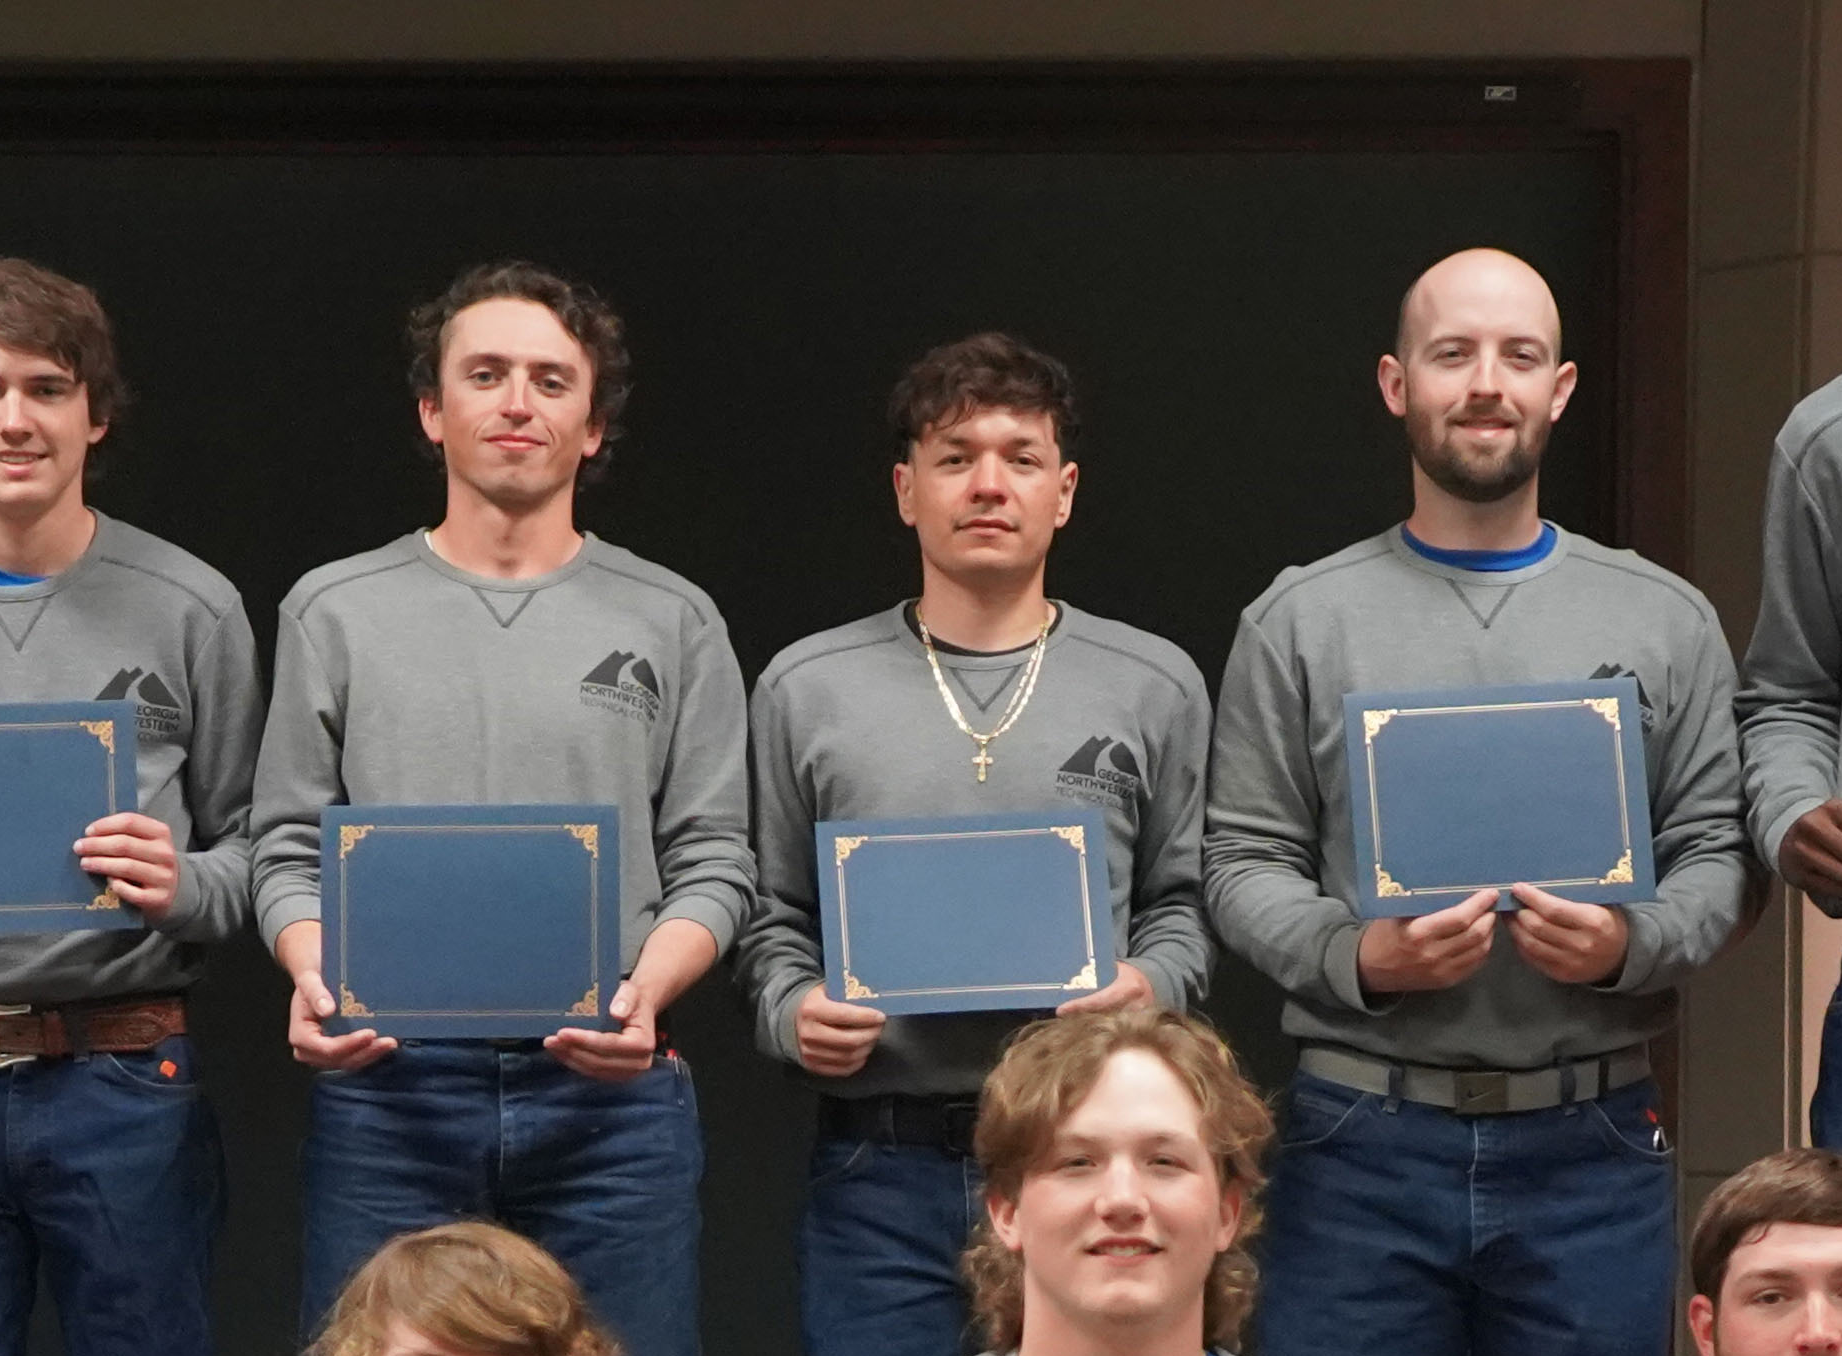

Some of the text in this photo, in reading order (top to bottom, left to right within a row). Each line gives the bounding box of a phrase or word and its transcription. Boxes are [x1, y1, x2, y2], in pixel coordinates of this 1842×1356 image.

[135, 704, 180, 721] EORGIA
[1056, 773, 1135, 800] NORTHWESTE
[1097, 768, 1134, 789] GEORG
